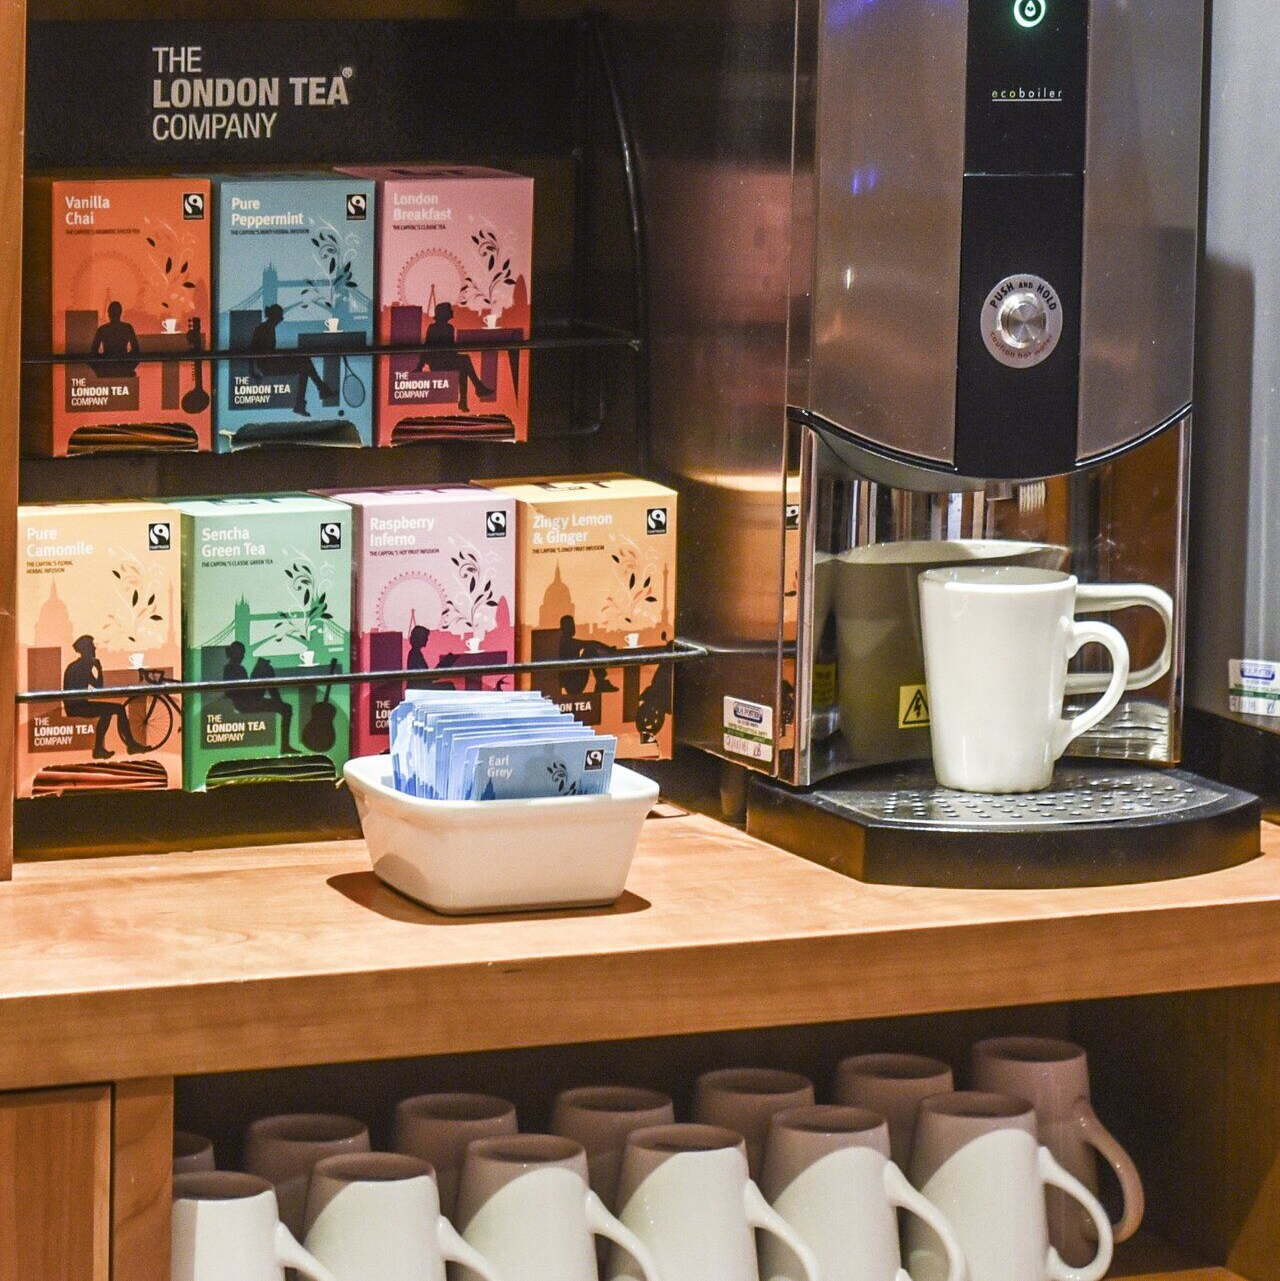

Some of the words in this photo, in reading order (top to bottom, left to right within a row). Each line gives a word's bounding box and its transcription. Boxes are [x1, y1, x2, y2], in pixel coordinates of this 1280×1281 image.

[152, 46, 202, 73] THE
[152, 77, 279, 108] LONDON
[992, 87, 1062, 99] ecoboiler
[152, 112, 278, 140] COMPANY
[65, 196, 110, 209] Vanilla
[231, 197, 260, 211] Pure
[393, 193, 438, 205] London
[65, 212, 95, 225] Chai
[231, 212, 303, 227] Peppermint
[393, 208, 452, 220] Breakfast
[990, 282, 1014, 308] PUSH
[1019, 281, 1033, 289] AND
[1036, 284, 1057, 310] HOLD
[990, 331, 1015, 358] caution
[72, 378, 86, 386] THE
[234, 376, 249, 385] THE
[395, 372, 408, 380] THE
[234, 385, 271, 395] LONDON
[273, 384, 291, 393] TEA
[394, 380, 430, 389] LONDON
[432, 379, 449, 389] TEA
[71, 387, 109, 396] LONDON
[111, 386, 129, 395] TEA
[394, 390, 429, 399] COMPANY
[71, 396, 108, 406] COMPANY
[234, 394, 270, 404] COMPANY
[370, 516, 435, 532] Raspberry
[532, 514, 569, 531] Zingy
[572, 513, 613, 526] Lemon
[26, 527, 57, 540] Pure
[201, 526, 250, 541] Sencha
[533, 532, 543, 545] &
[546, 530, 588, 545] Ginger
[370, 533, 416, 547] Inferno
[26, 542, 94, 557] Camomile
[201, 544, 241, 557] Green
[243, 542, 266, 556] Tea
[376, 700, 391, 709] THE
[574, 701, 592, 712] TEA
[34, 717, 50, 726] THE
[207, 714, 222, 723] THE
[34, 725, 74, 736] LONDON
[76, 725, 95, 735] TEA
[206, 723, 246, 733] LONDON
[247, 721, 266, 731] TEA
[34, 736, 73, 747] COMPANY
[206, 733, 245, 743] COMPANY
[488, 755, 510, 766] Earl
[487, 768, 513, 780] Grey
